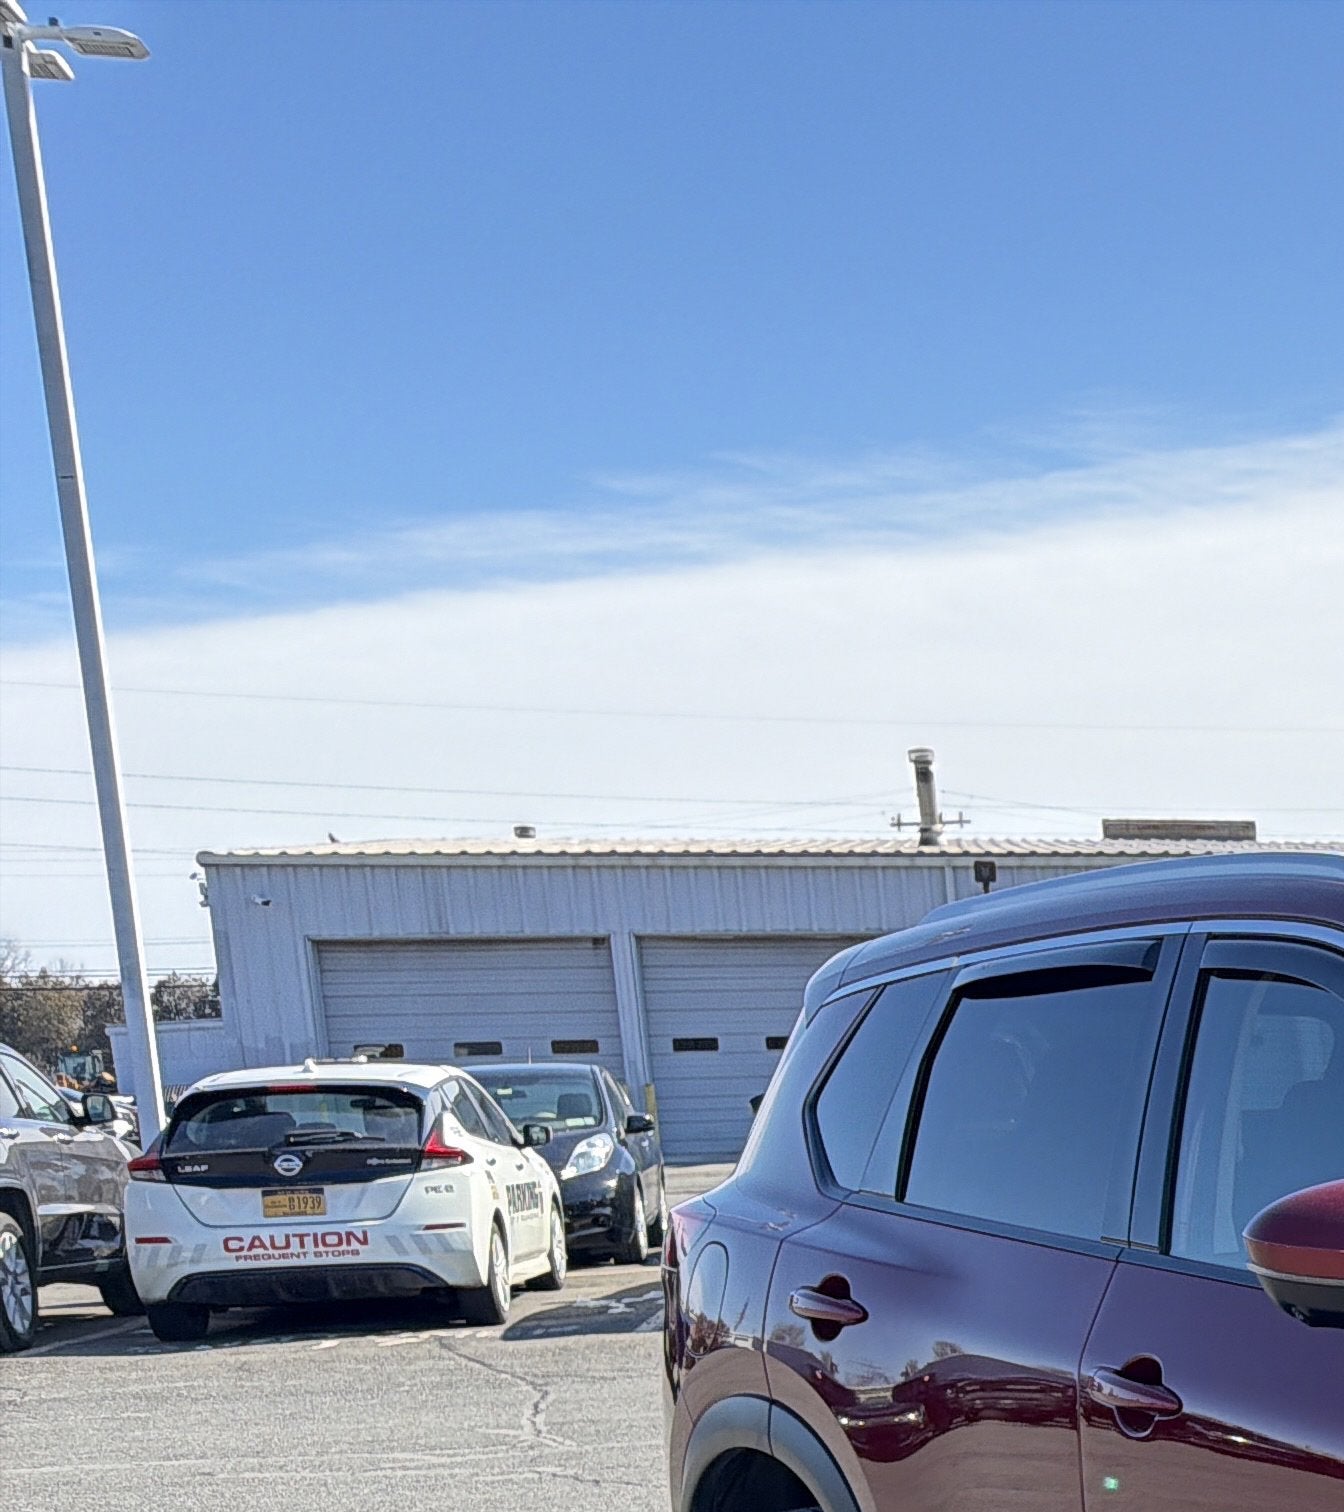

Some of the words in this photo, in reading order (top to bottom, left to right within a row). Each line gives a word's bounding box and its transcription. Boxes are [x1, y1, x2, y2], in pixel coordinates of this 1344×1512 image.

[177, 1165, 209, 1173] LEAF
[222, 1229, 369, 1253] CAUTION
[235, 1251, 309, 1262] FREQUENT
[314, 1249, 360, 1258] STOPS
